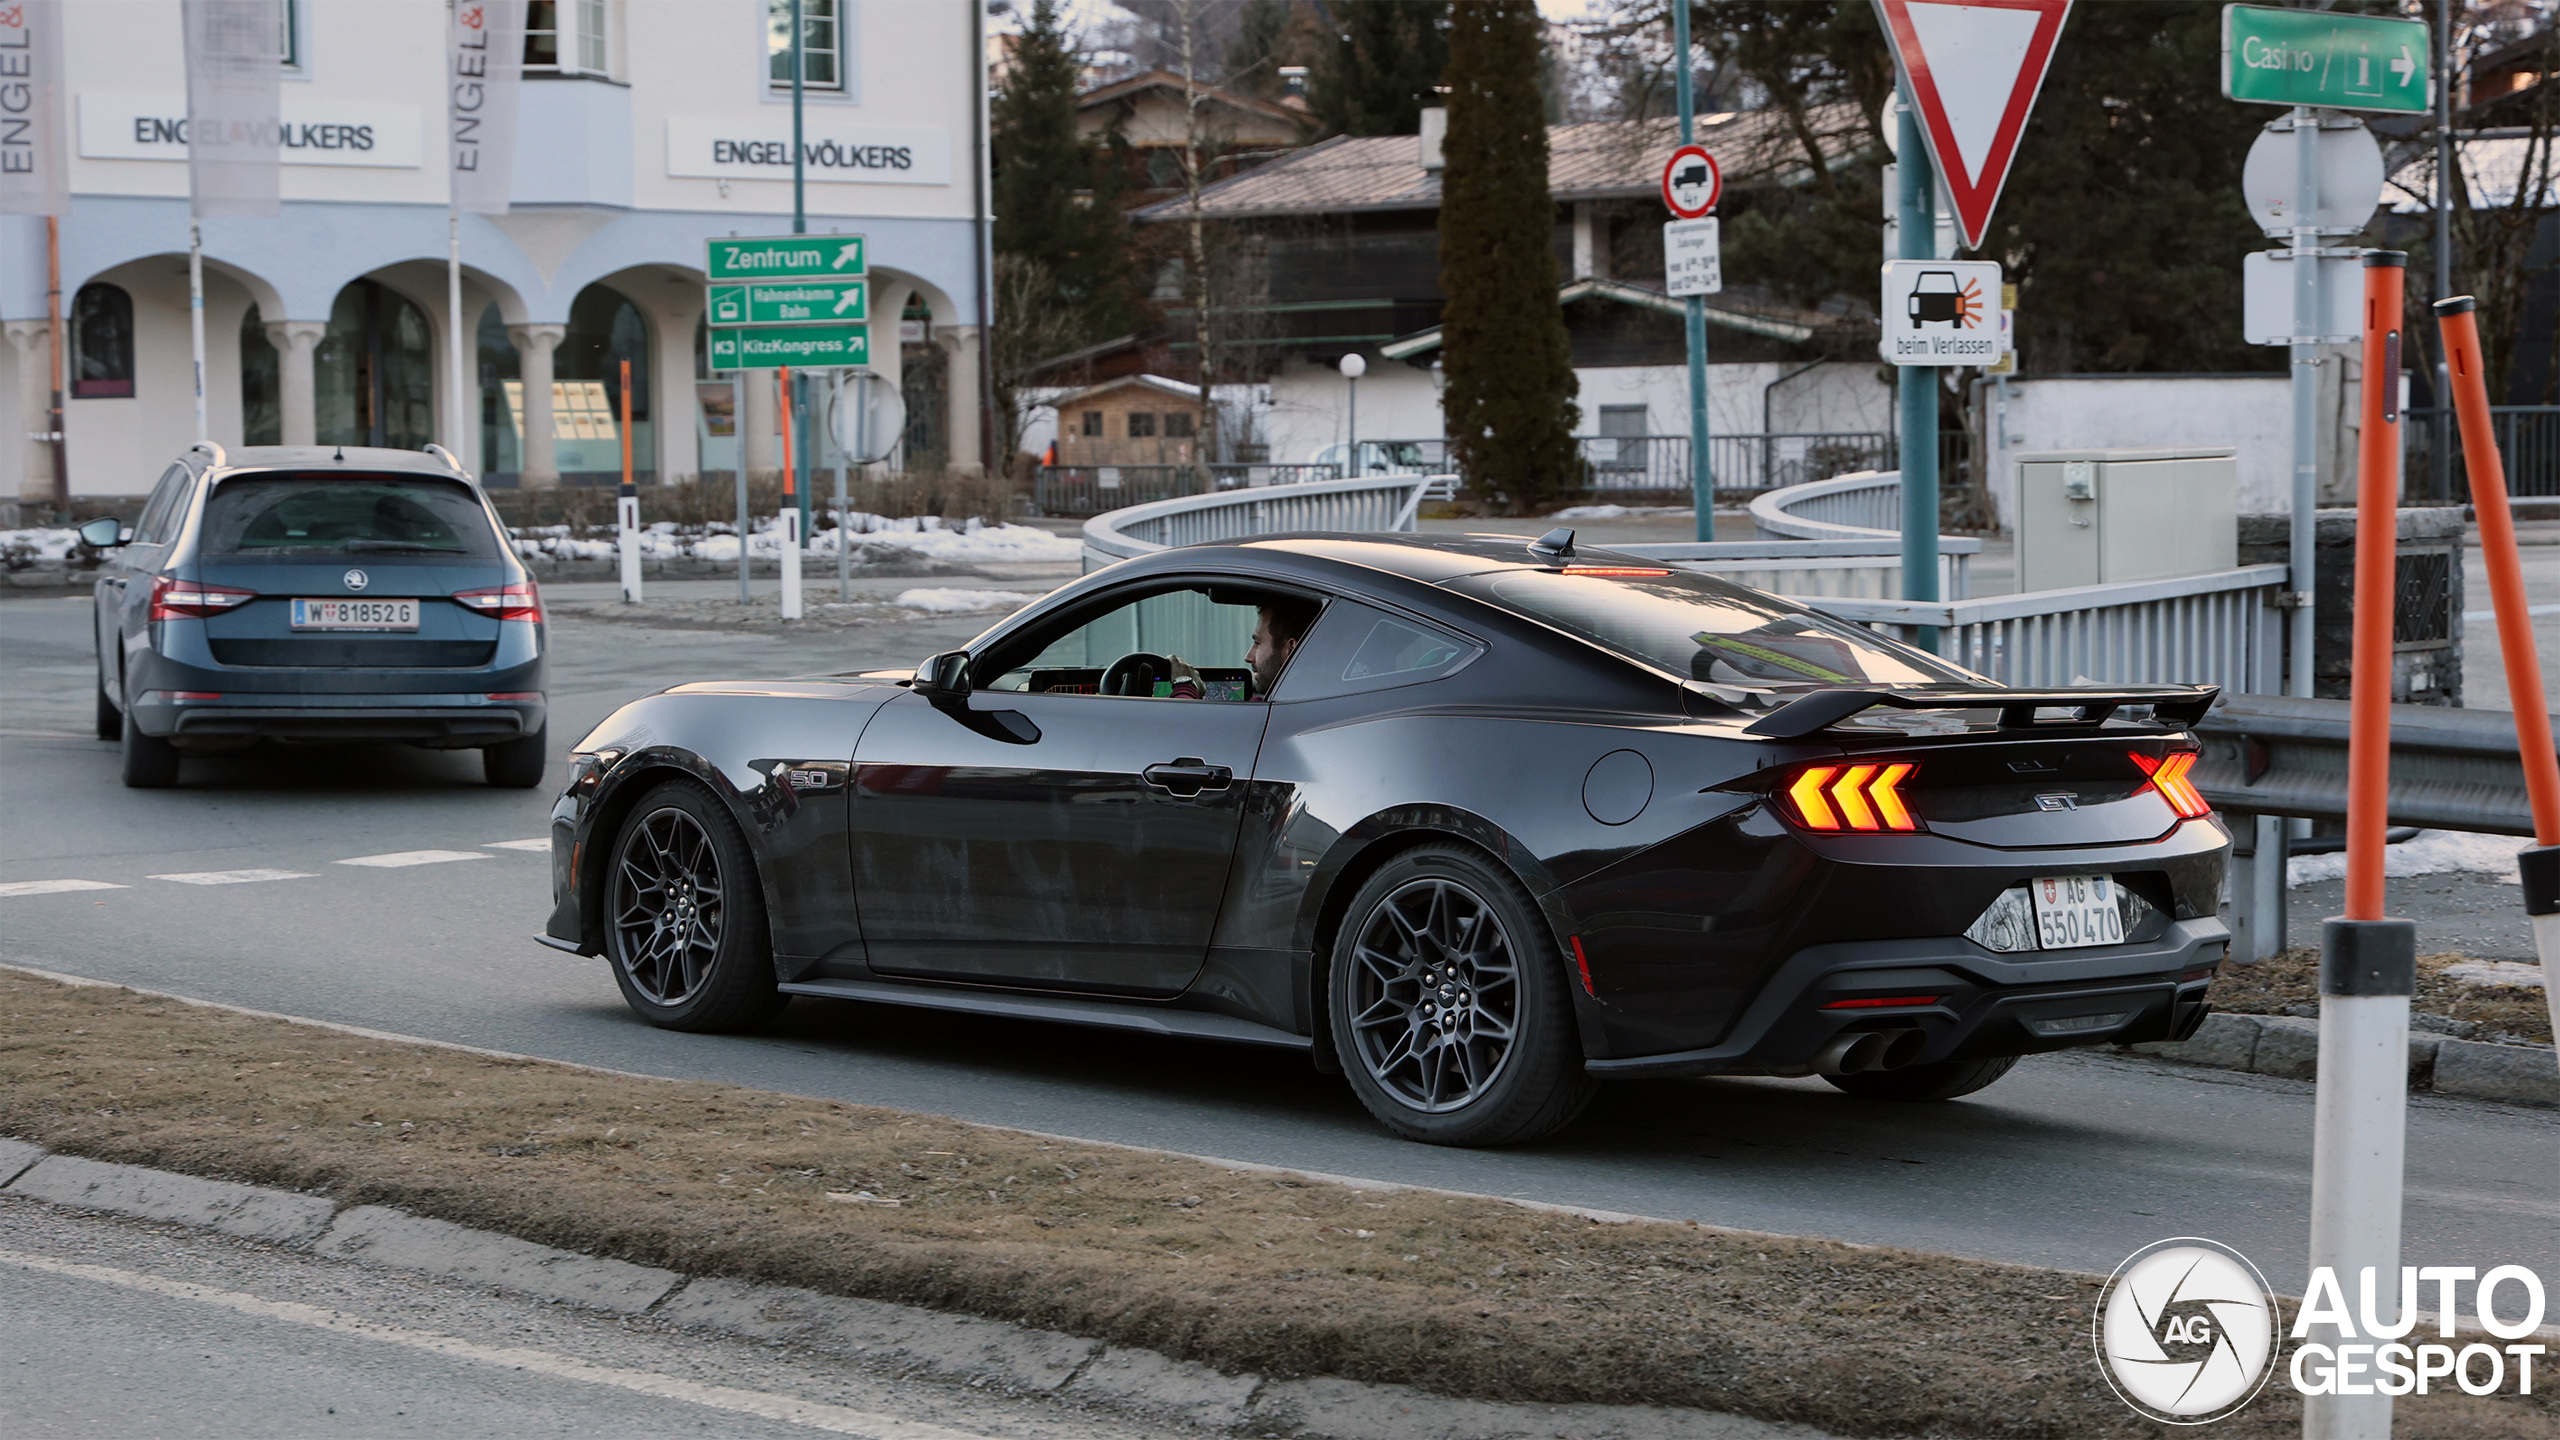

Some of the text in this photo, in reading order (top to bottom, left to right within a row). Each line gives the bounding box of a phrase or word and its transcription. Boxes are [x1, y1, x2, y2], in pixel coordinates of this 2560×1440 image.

[2243, 36, 2315, 72] Casino
[455, 0, 488, 172] ENGEL&
[713, 139, 911, 170] ENGELVÖLKERS
[725, 247, 821, 269] Zentrum
[754, 287, 835, 302] Hahnenkamm
[779, 304, 811, 319] Bahn
[714, 338, 843, 356] K3 KitzKongress
[1897, 335, 1928, 354] beim
[1932, 336, 1993, 354] Verlassen
[790, 770, 828, 787] 5.0
[2034, 792, 2078, 812] GT
[2066, 877, 2085, 904] AG
[2041, 907, 2120, 945] 550 470
